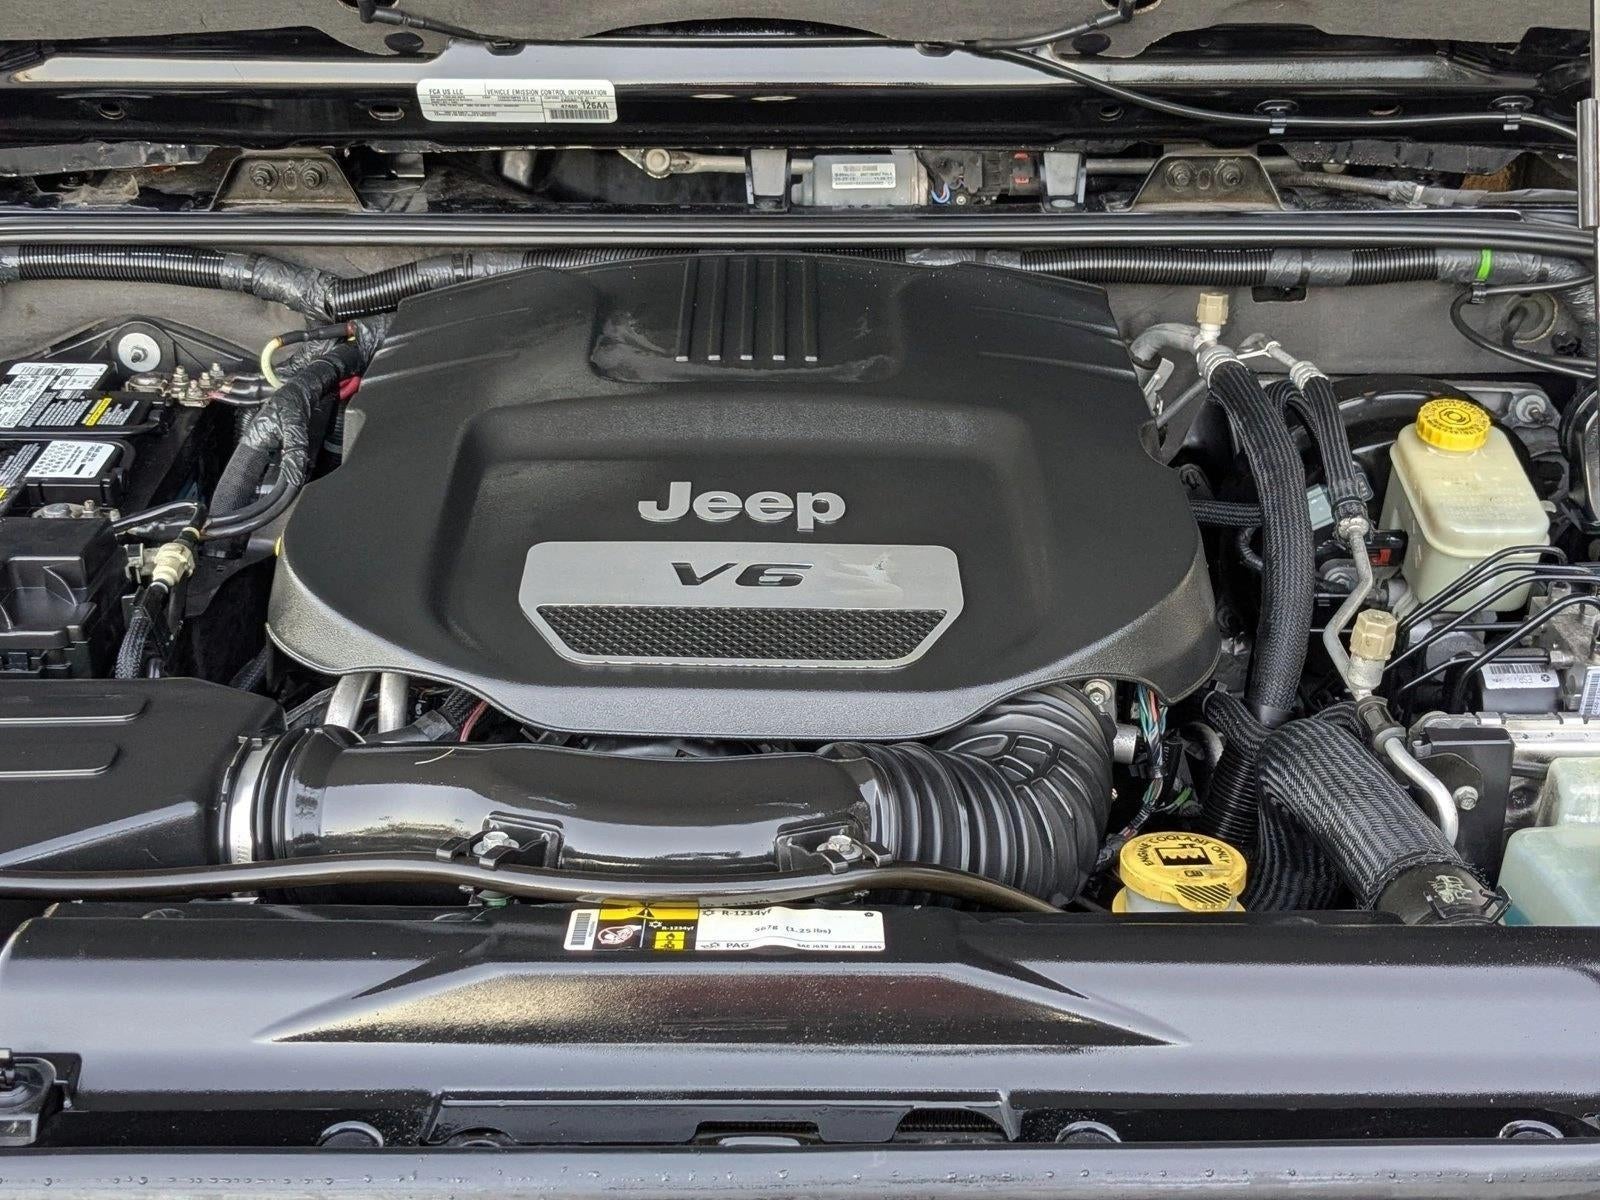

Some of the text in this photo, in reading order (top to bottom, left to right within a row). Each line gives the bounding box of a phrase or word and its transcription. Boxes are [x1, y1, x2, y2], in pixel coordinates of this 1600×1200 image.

[582, 102, 609, 110] 126AA
[637, 481, 847, 532] Jeep
[670, 562, 815, 587] V6
[1136, 834, 1231, 867] ENGINE COOLANT ONLY
